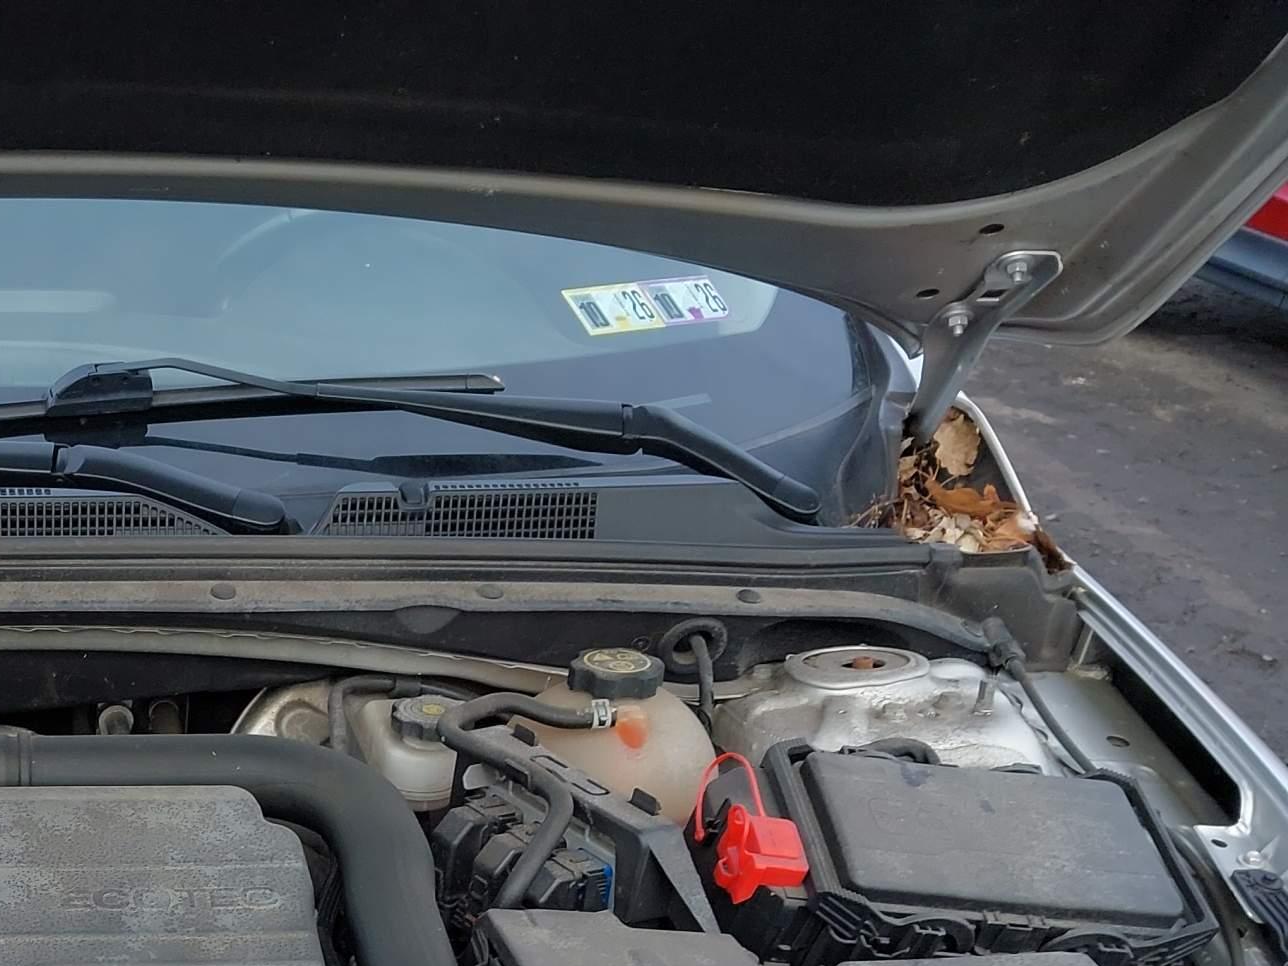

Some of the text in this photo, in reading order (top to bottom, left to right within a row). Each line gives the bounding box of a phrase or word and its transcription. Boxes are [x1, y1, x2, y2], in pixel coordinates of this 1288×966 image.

[579, 290, 655, 328] 10 26
[694, 283, 727, 313] 26
